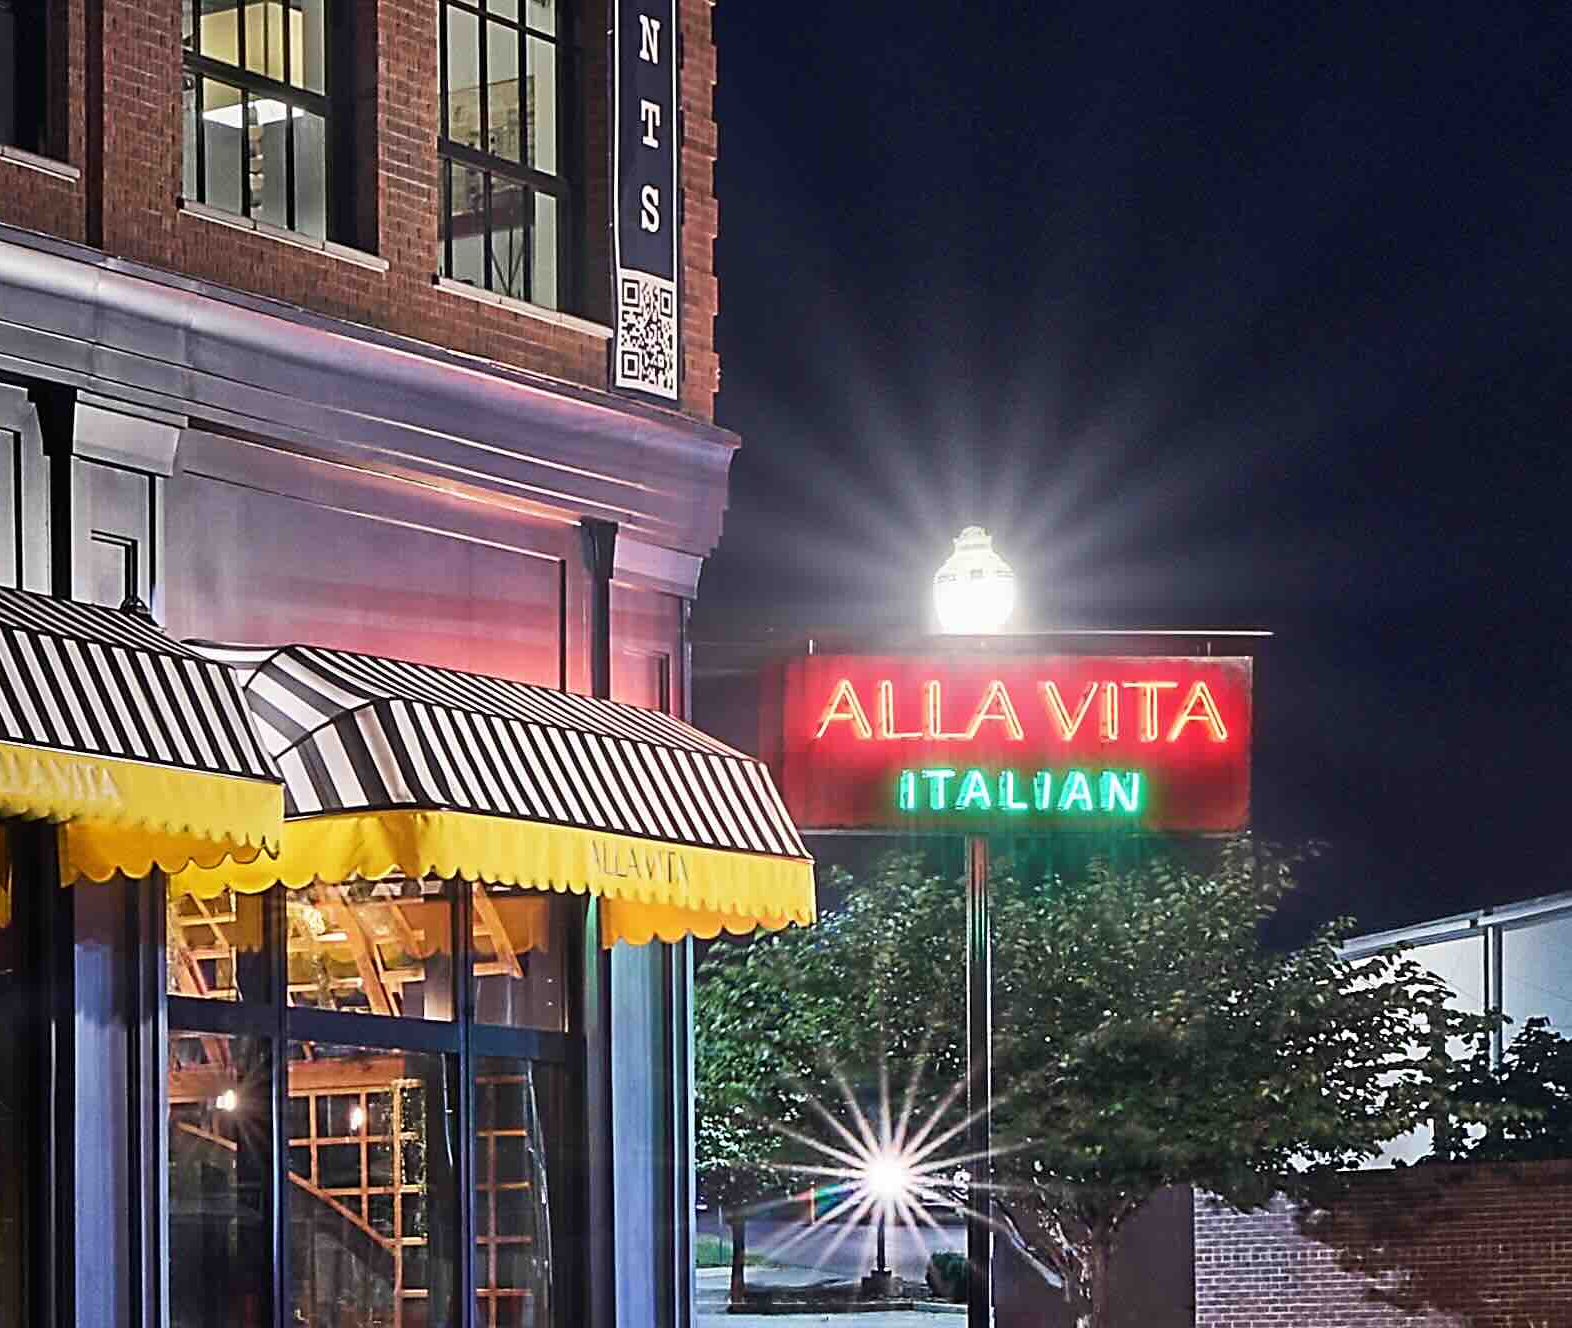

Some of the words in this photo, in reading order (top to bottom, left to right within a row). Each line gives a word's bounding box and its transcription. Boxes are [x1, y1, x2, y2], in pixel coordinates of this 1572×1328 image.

[815, 678, 1024, 742] ALLA
[1041, 679, 1229, 742] VITA
[899, 768, 1142, 812] ITALIAN
